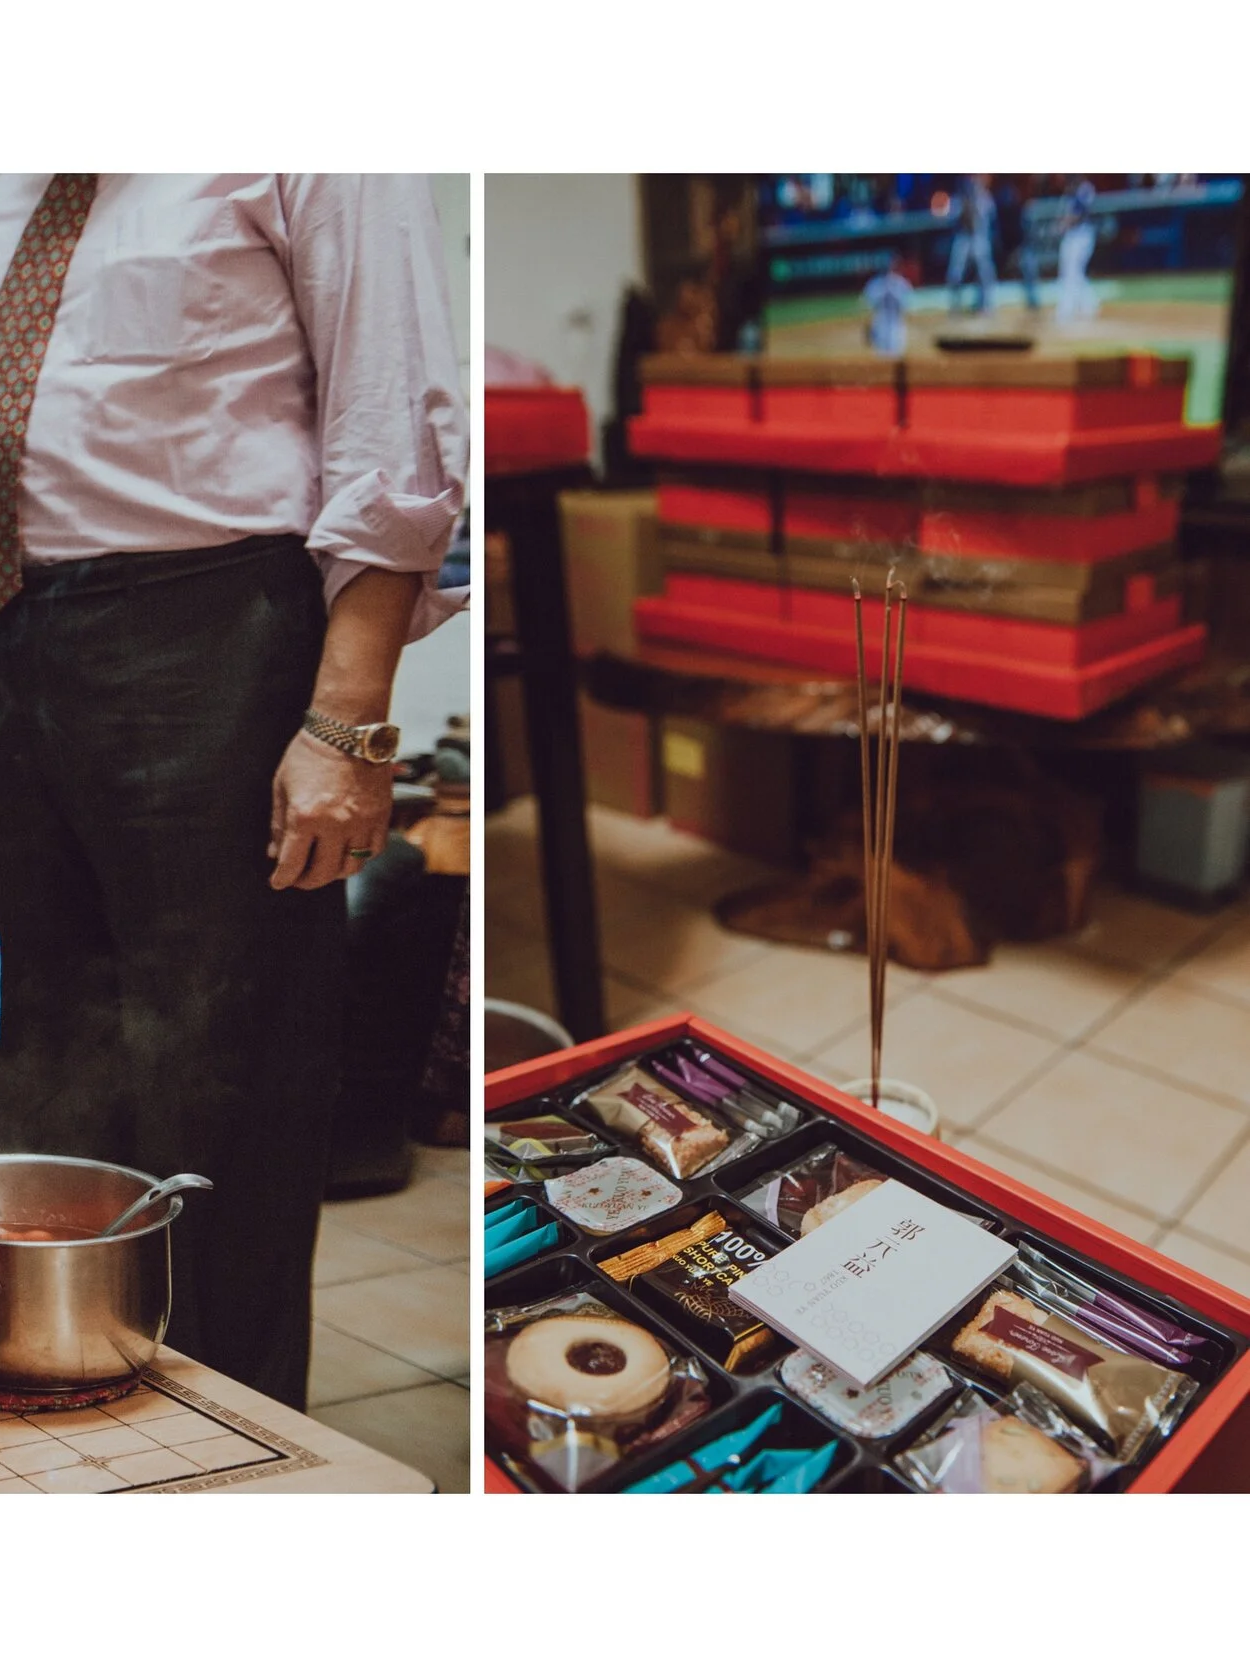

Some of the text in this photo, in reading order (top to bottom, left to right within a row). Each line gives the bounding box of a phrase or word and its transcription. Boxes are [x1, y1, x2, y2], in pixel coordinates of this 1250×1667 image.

[840, 1217, 926, 1279] 郭元益
[830, 1275, 849, 1291] KUO
